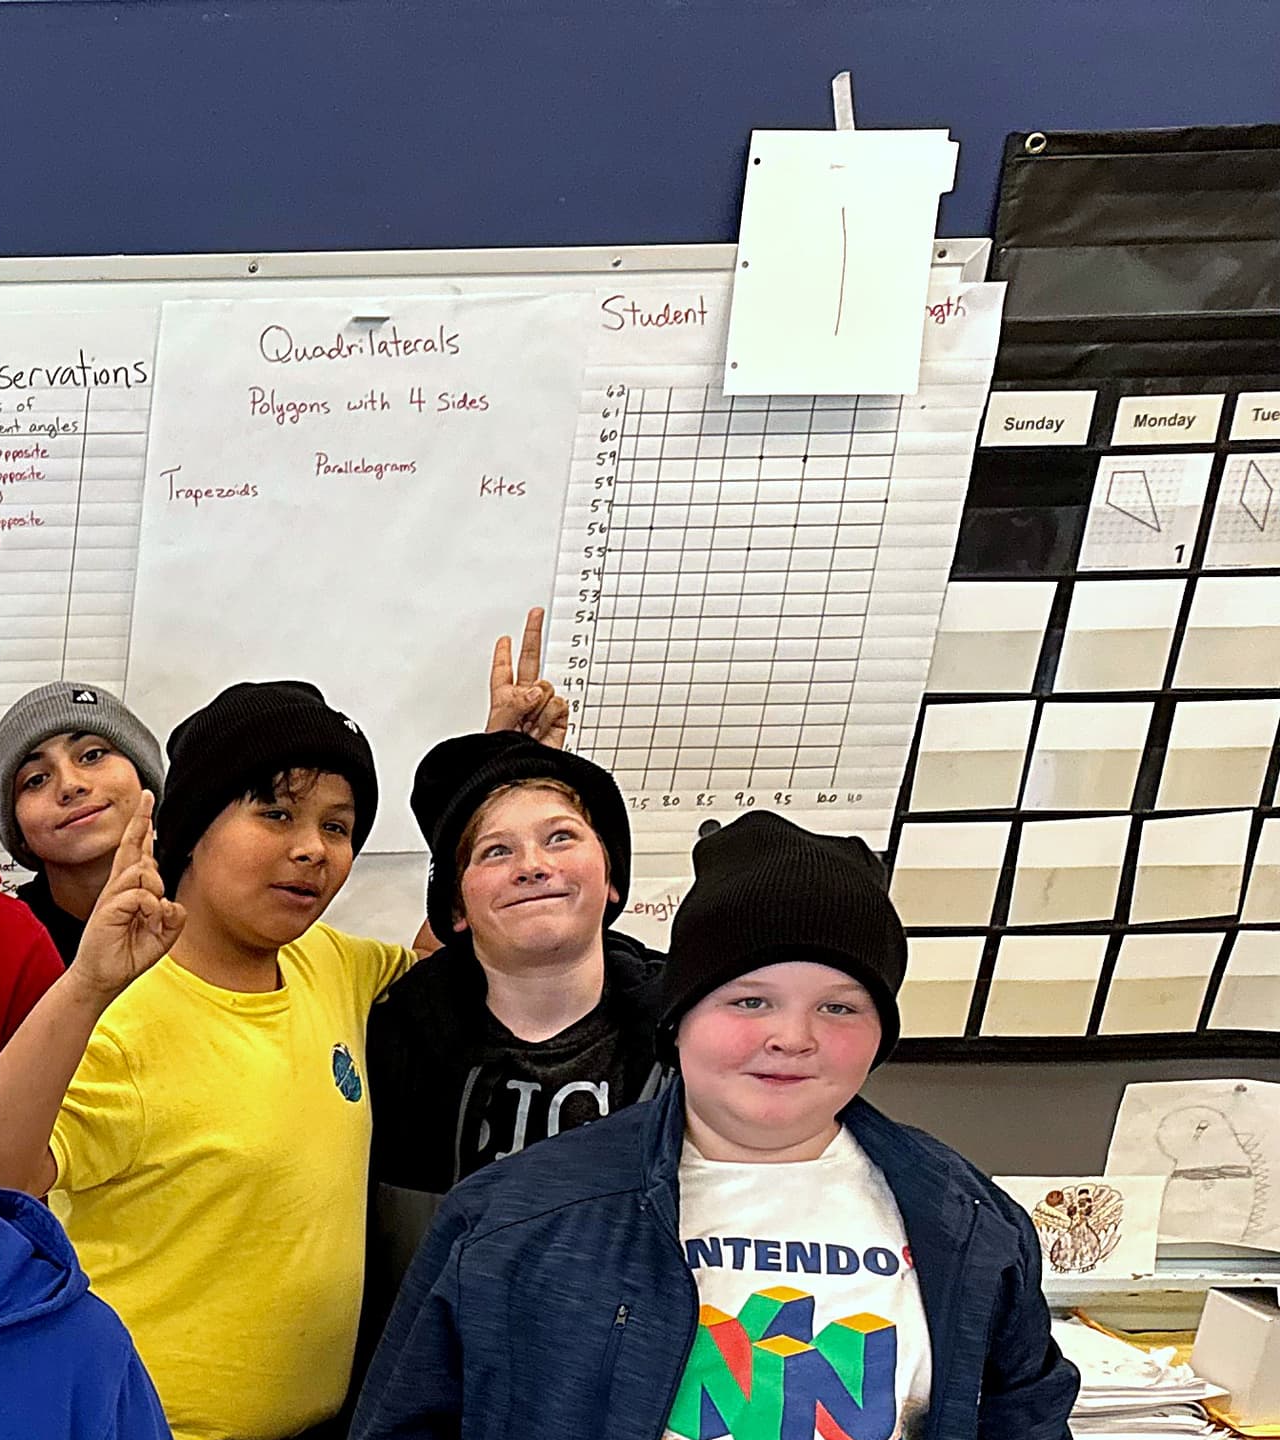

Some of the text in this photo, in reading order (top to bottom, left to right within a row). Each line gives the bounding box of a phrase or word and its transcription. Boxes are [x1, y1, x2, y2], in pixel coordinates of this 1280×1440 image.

[600, 294, 709, 332] Student
[259, 325, 461, 364] Quadrilaterals
[16, 396, 36, 413] of
[248, 385, 331, 427] Polygons
[346, 389, 391, 413] with
[408, 386, 427, 414] 4
[602, 406, 620, 419] 61
[1133, 412, 1197, 430] Monday
[1252, 407, 1280, 422] Tue
[28, 416, 79, 439] angles
[1003, 416, 1065, 434] Sunday
[599, 429, 619, 443] 60
[314, 451, 418, 481] Parallelograms
[596, 450, 618, 467] 59
[159, 464, 260, 508] Trapezoids
[479, 475, 527, 499] Kites
[594, 476, 615, 490] 58
[590, 498, 615, 515] 57
[586, 522, 608, 536] 56
[583, 545, 607, 560] 55
[1174, 543, 1186, 564] 1
[580, 567, 603, 583] 54
[578, 588, 601, 604] 53
[574, 611, 599, 625] 52
[571, 633, 589, 648] 51
[568, 656, 589, 670] 50
[563, 677, 585, 692] 49
